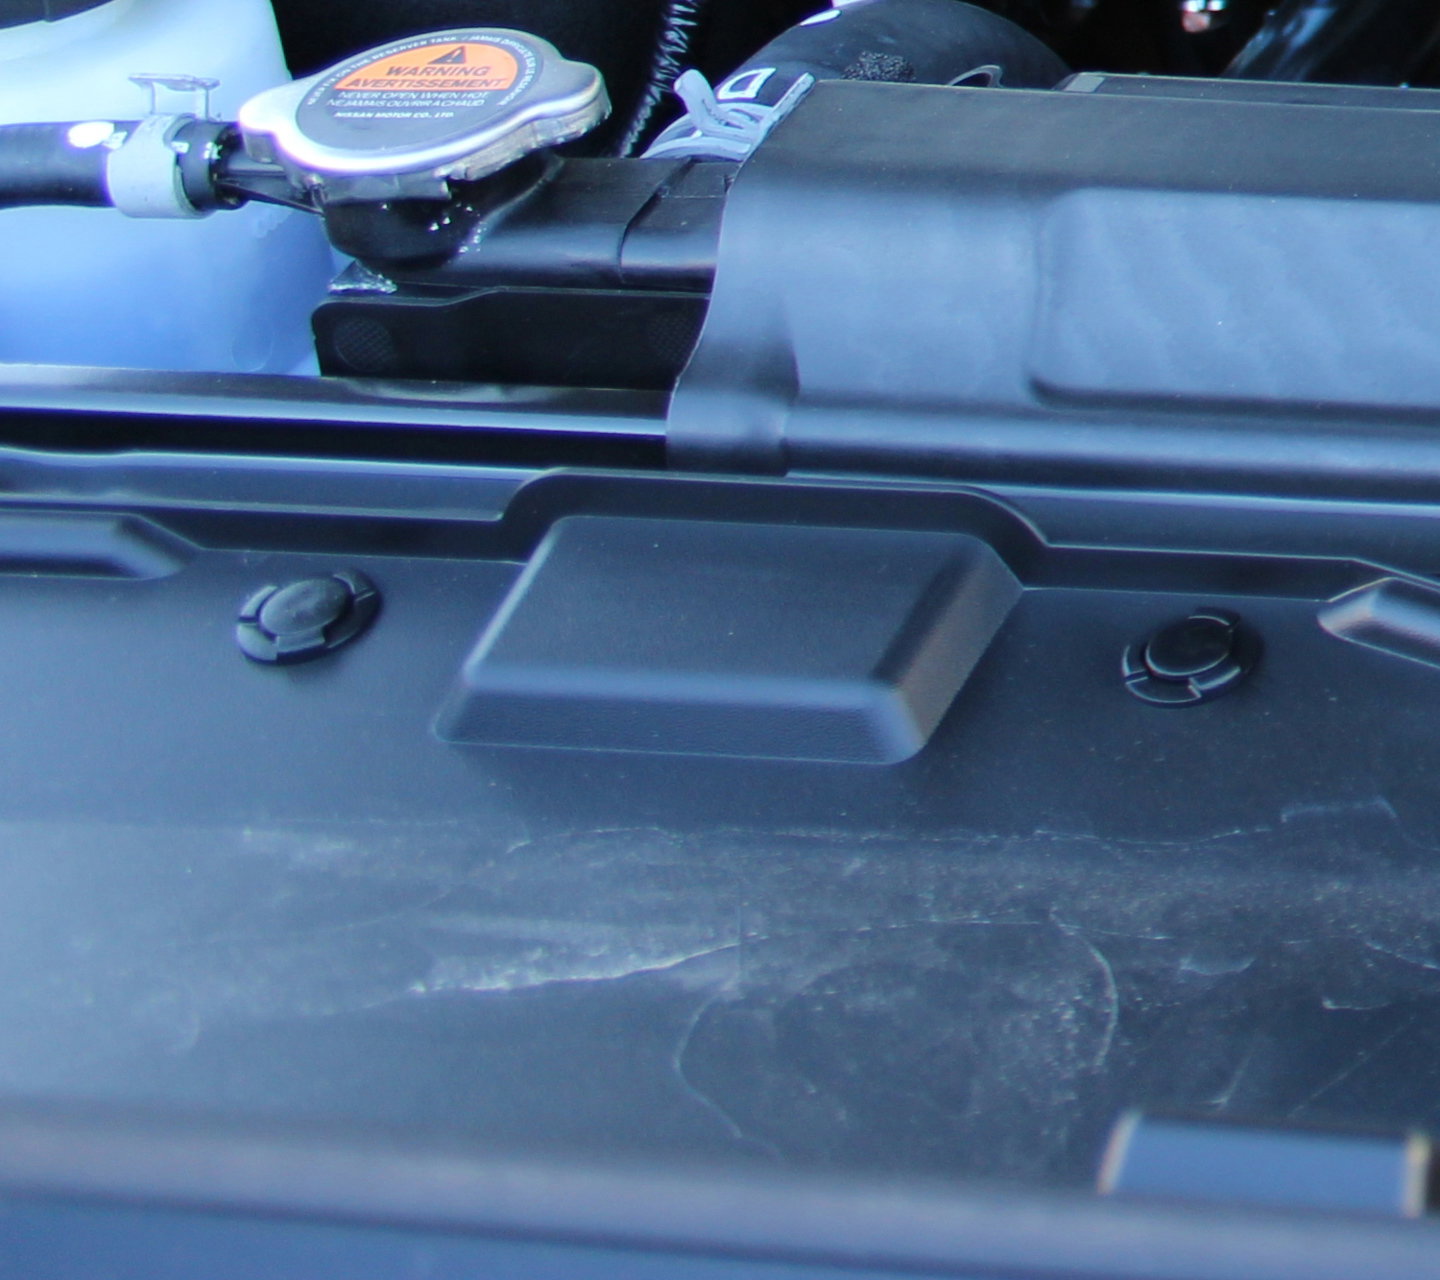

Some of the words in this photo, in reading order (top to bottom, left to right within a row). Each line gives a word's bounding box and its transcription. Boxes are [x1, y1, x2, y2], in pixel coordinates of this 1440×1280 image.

[386, 66, 492, 77] WARNING
[345, 77, 509, 88] AVERTISSEMENT
[339, 90, 381, 99] NEVER
[384, 90, 419, 99] OPEN
[421, 90, 458, 99] WHEN
[333, 111, 374, 119] NISSAN
[374, 111, 412, 119] MOTOR
